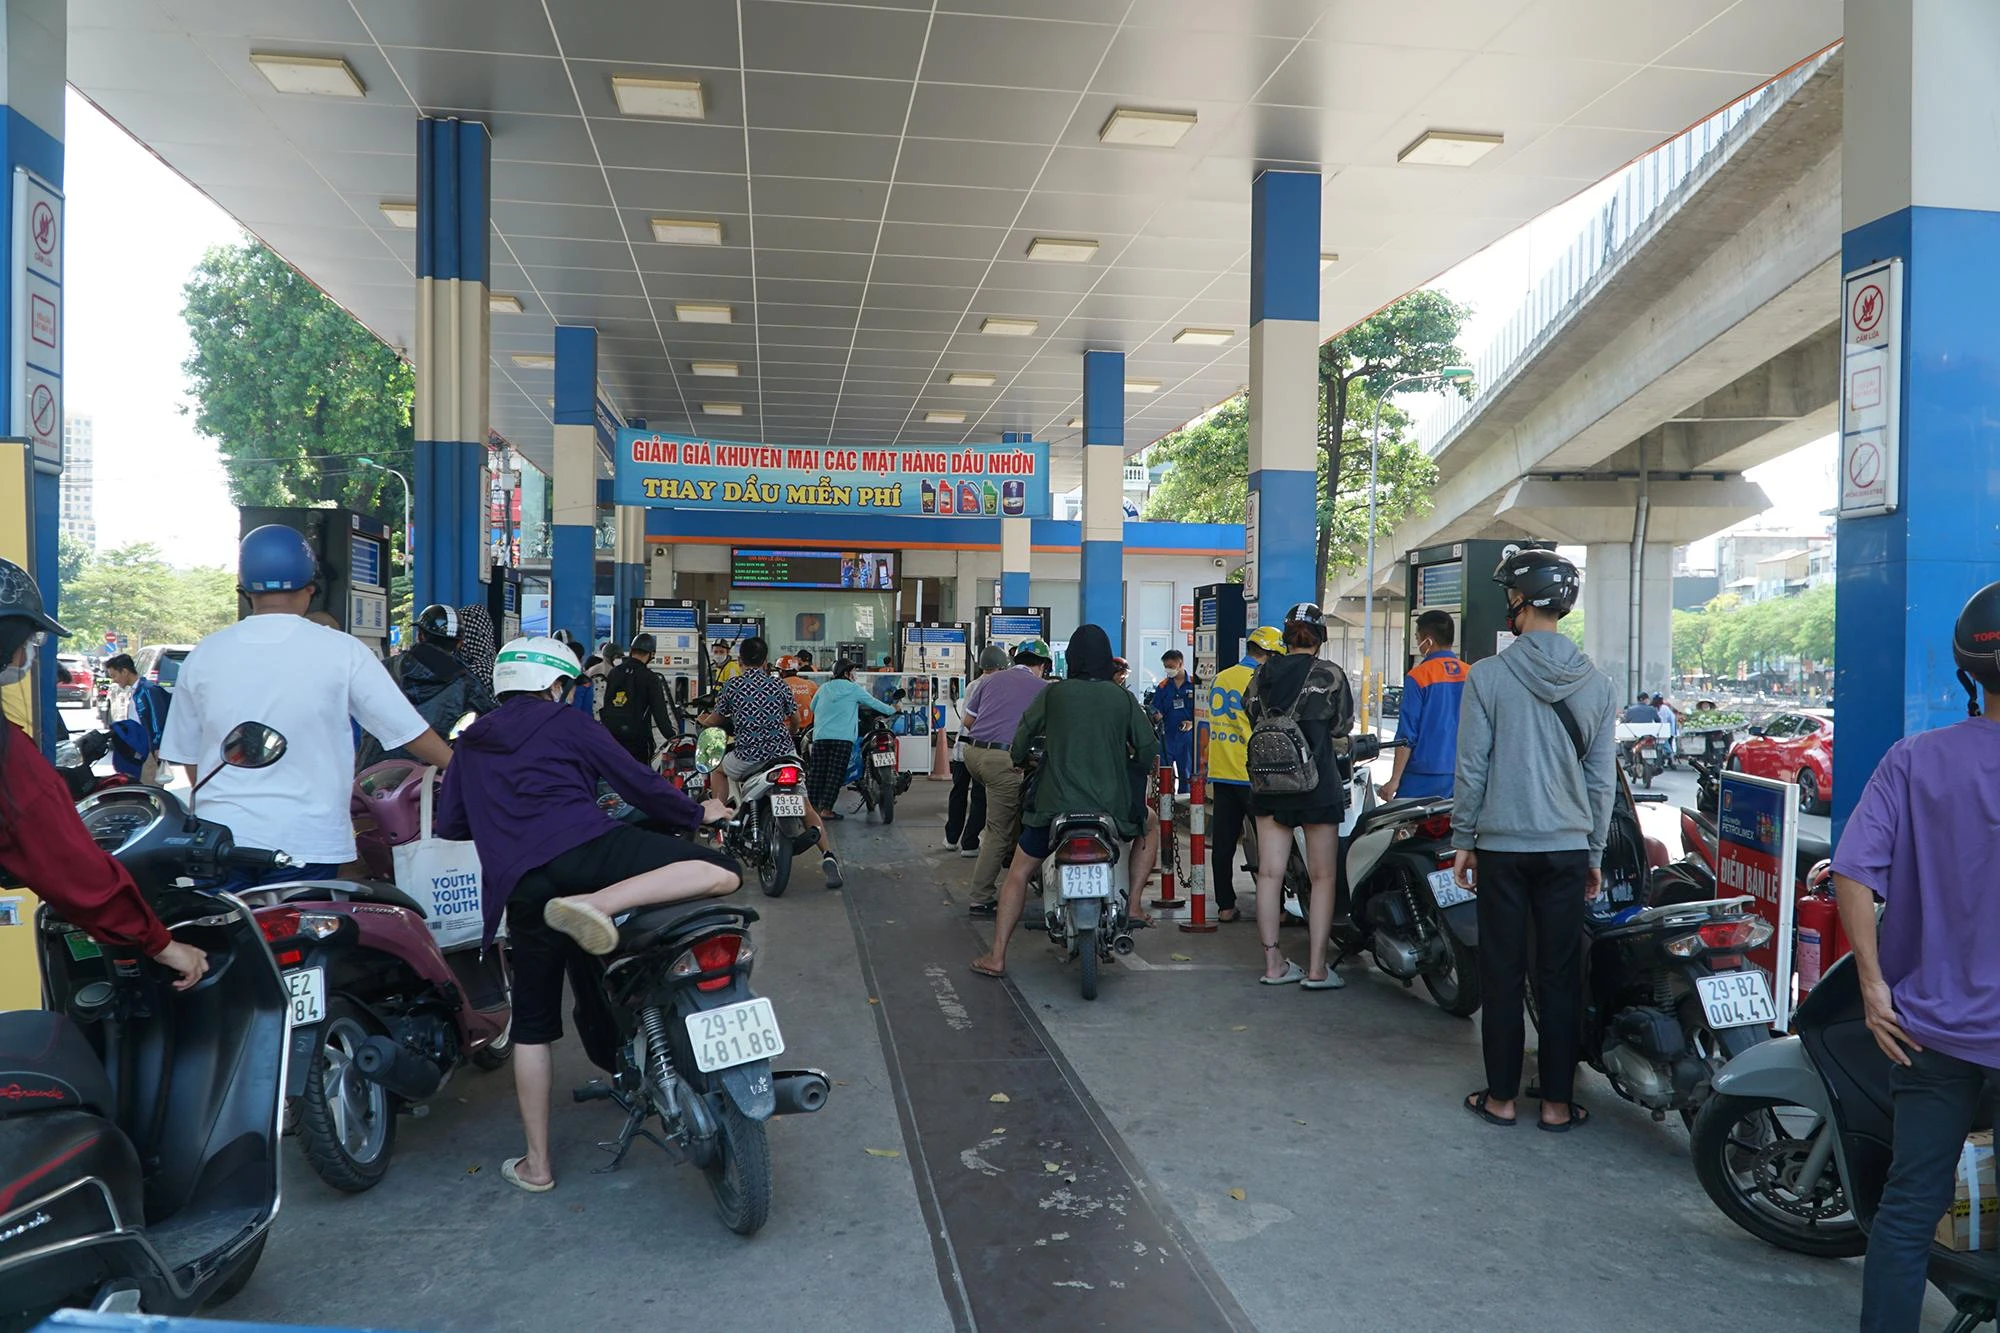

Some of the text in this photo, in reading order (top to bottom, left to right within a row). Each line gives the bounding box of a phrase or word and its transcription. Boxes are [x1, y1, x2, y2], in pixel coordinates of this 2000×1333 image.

[633, 436, 677, 463] GIẢM
[683, 441, 711, 466] GIÁ
[787, 449, 819, 474] MẠI
[862, 449, 897, 476] MẶT
[902, 449, 946, 473] HÀNG
[951, 448, 984, 473] DẦU
[988, 449, 1033, 474] NHỜN
[642, 474, 902, 507] THAY DẦU MIỄN PHÍ
[774, 805, 804, 815] 295.65
[776, 796, 800, 805] 29-E2
[1721, 822, 1755, 841] PETROLIMEX
[431, 873, 476, 889] YOUTH
[1066, 865, 1102, 881] 29-K9
[1720, 849, 1778, 905] ĐIỂM BÁN LẺ
[432, 886, 477, 902] YOUTH
[1067, 881, 1102, 896] 7431
[433, 899, 479, 916] YOUTH
[1707, 976, 1759, 1001] 29-B2
[1709, 997, 1771, 1024] 004.41
[700, 1005, 760, 1040] 29-P1
[703, 1029, 777, 1066] 481.86
